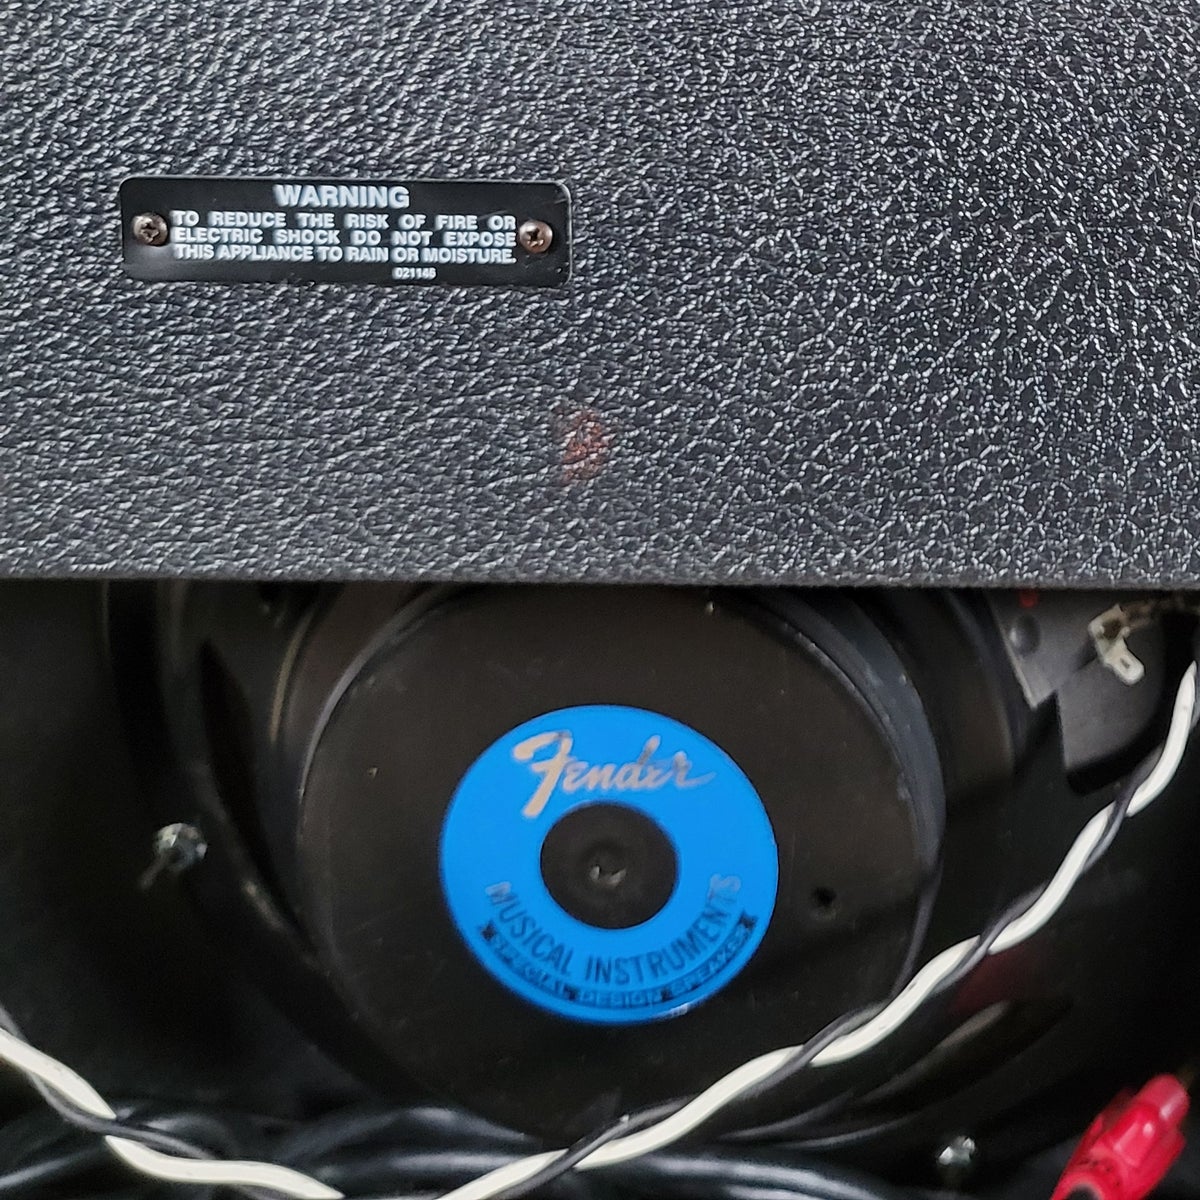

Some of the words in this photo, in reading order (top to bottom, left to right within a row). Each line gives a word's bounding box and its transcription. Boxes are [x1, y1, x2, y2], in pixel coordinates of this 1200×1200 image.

[274, 184, 410, 209] WARNING
[171, 210, 200, 229] TO
[208, 211, 287, 228] REDUCE
[297, 212, 335, 229] THE
[344, 213, 390, 230] RISK
[398, 213, 426, 230] OF
[435, 214, 478, 231] FIRE
[488, 215, 516, 231] OR
[170, 226, 263, 245] ELECTRIC
[274, 228, 341, 245] SHOCK
[351, 229, 382, 246] DO
[391, 230, 433, 249] NOT
[443, 231, 517, 248] EXPOSE
[172, 243, 215, 260] THIS
[216, 244, 314, 262] APPLIANCE
[316, 245, 343, 262] TO
[345, 246, 389, 262] RAIN
[391, 246, 420, 263] OR
[421, 245, 517, 264] MOISTURE.
[512, 730, 716, 819] Fender
[485, 881, 574, 978] MUSICAL
[584, 873, 743, 986] INSTRUMENTS
